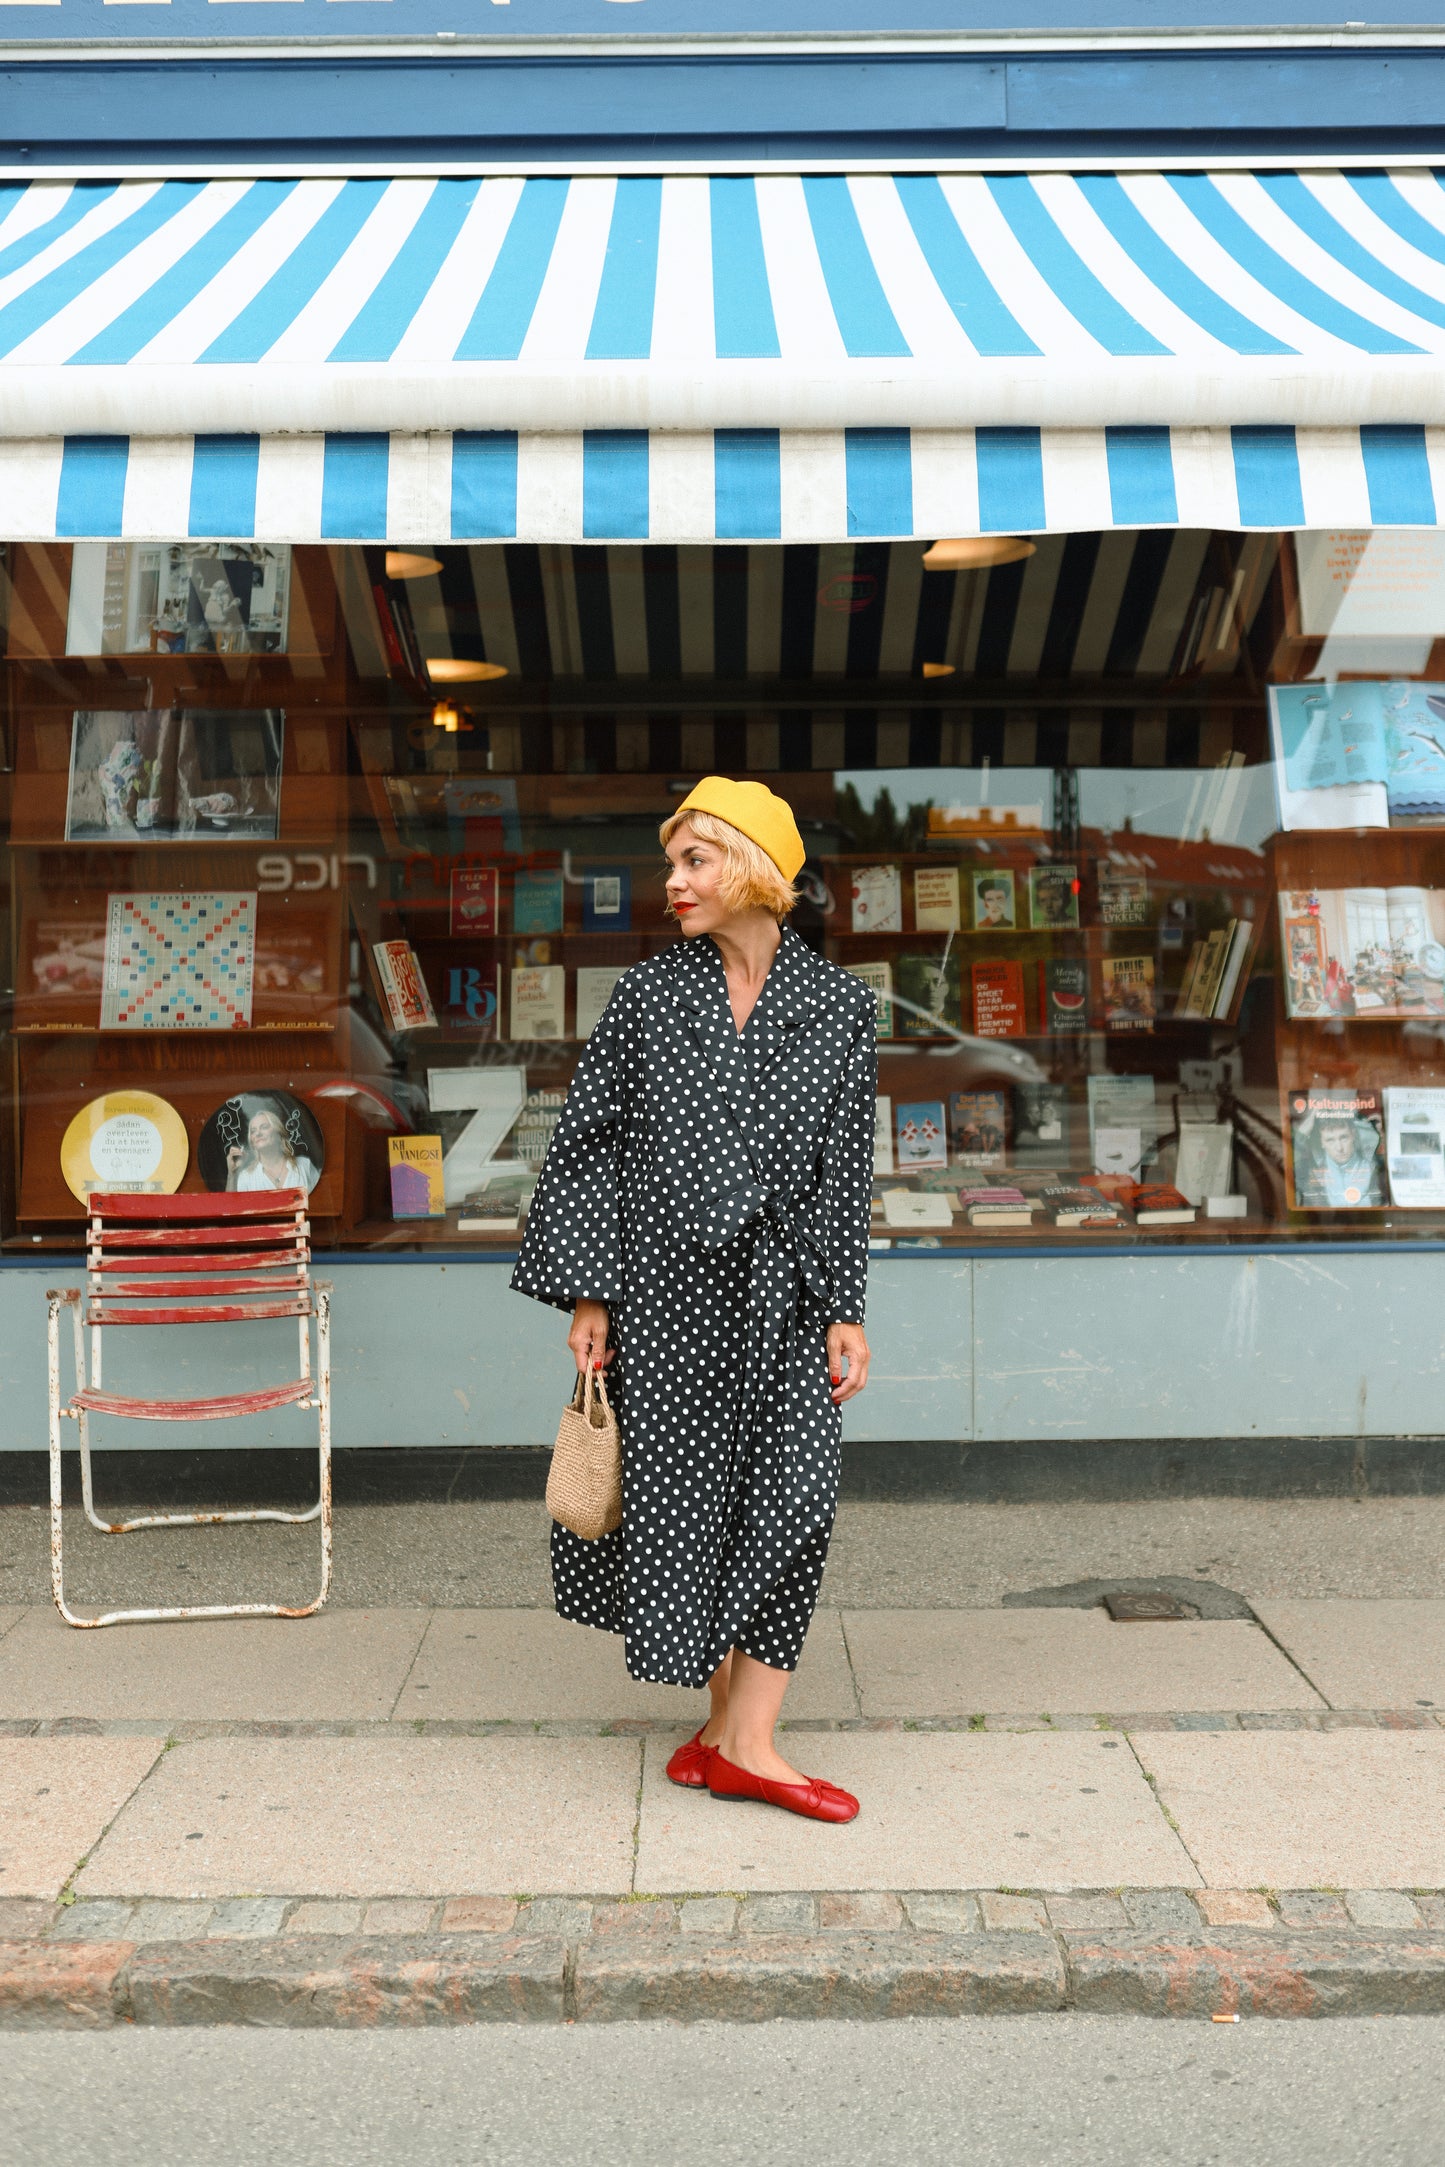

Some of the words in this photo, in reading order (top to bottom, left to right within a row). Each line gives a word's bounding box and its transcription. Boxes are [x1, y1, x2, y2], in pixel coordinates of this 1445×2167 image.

[978, 1019, 1014, 1028] FREMTID
[527, 1089, 562, 1107] ohn
[1308, 1097, 1376, 1110] Kulturspind
[115, 1147, 152, 1155] teenager
